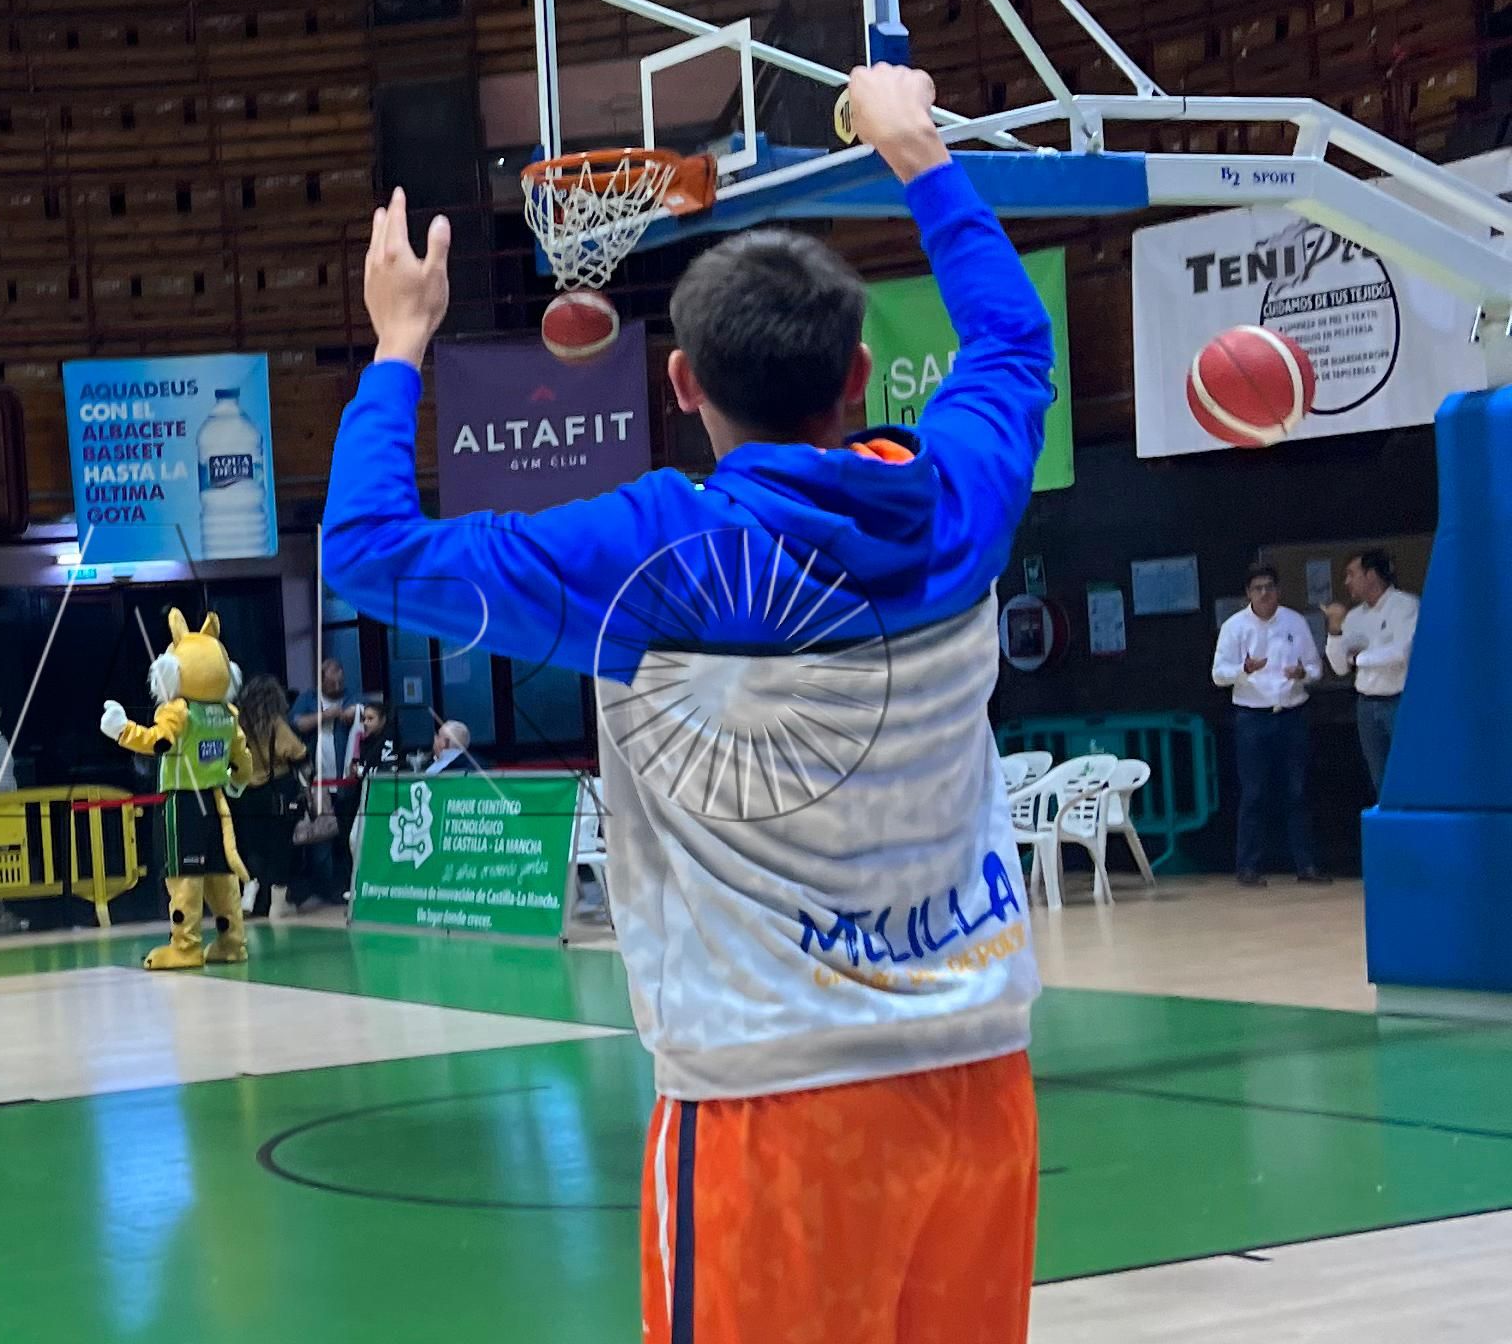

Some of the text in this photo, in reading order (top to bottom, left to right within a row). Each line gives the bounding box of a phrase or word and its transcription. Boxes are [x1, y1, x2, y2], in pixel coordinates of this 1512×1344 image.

[1253, 170, 1295, 186] SPORT
[1314, 294, 1327, 308] DE
[1330, 290, 1349, 306] TUS
[80, 379, 199, 401] AQUADEUS
[79, 401, 155, 422] CON EL
[82, 420, 187, 442] ALBACETE
[453, 411, 634, 454] ALTAFIT
[82, 442, 165, 462] BASKET
[83, 461, 188, 484] HASTA LA
[510, 454, 587, 471] GYM CLUB
[87, 505, 147, 525] GOTA
[447, 799, 476, 817] PARQUE
[453, 836, 488, 853] CASTILLA
[494, 838, 505, 854] LA
[505, 838, 542, 855] MANCHA
